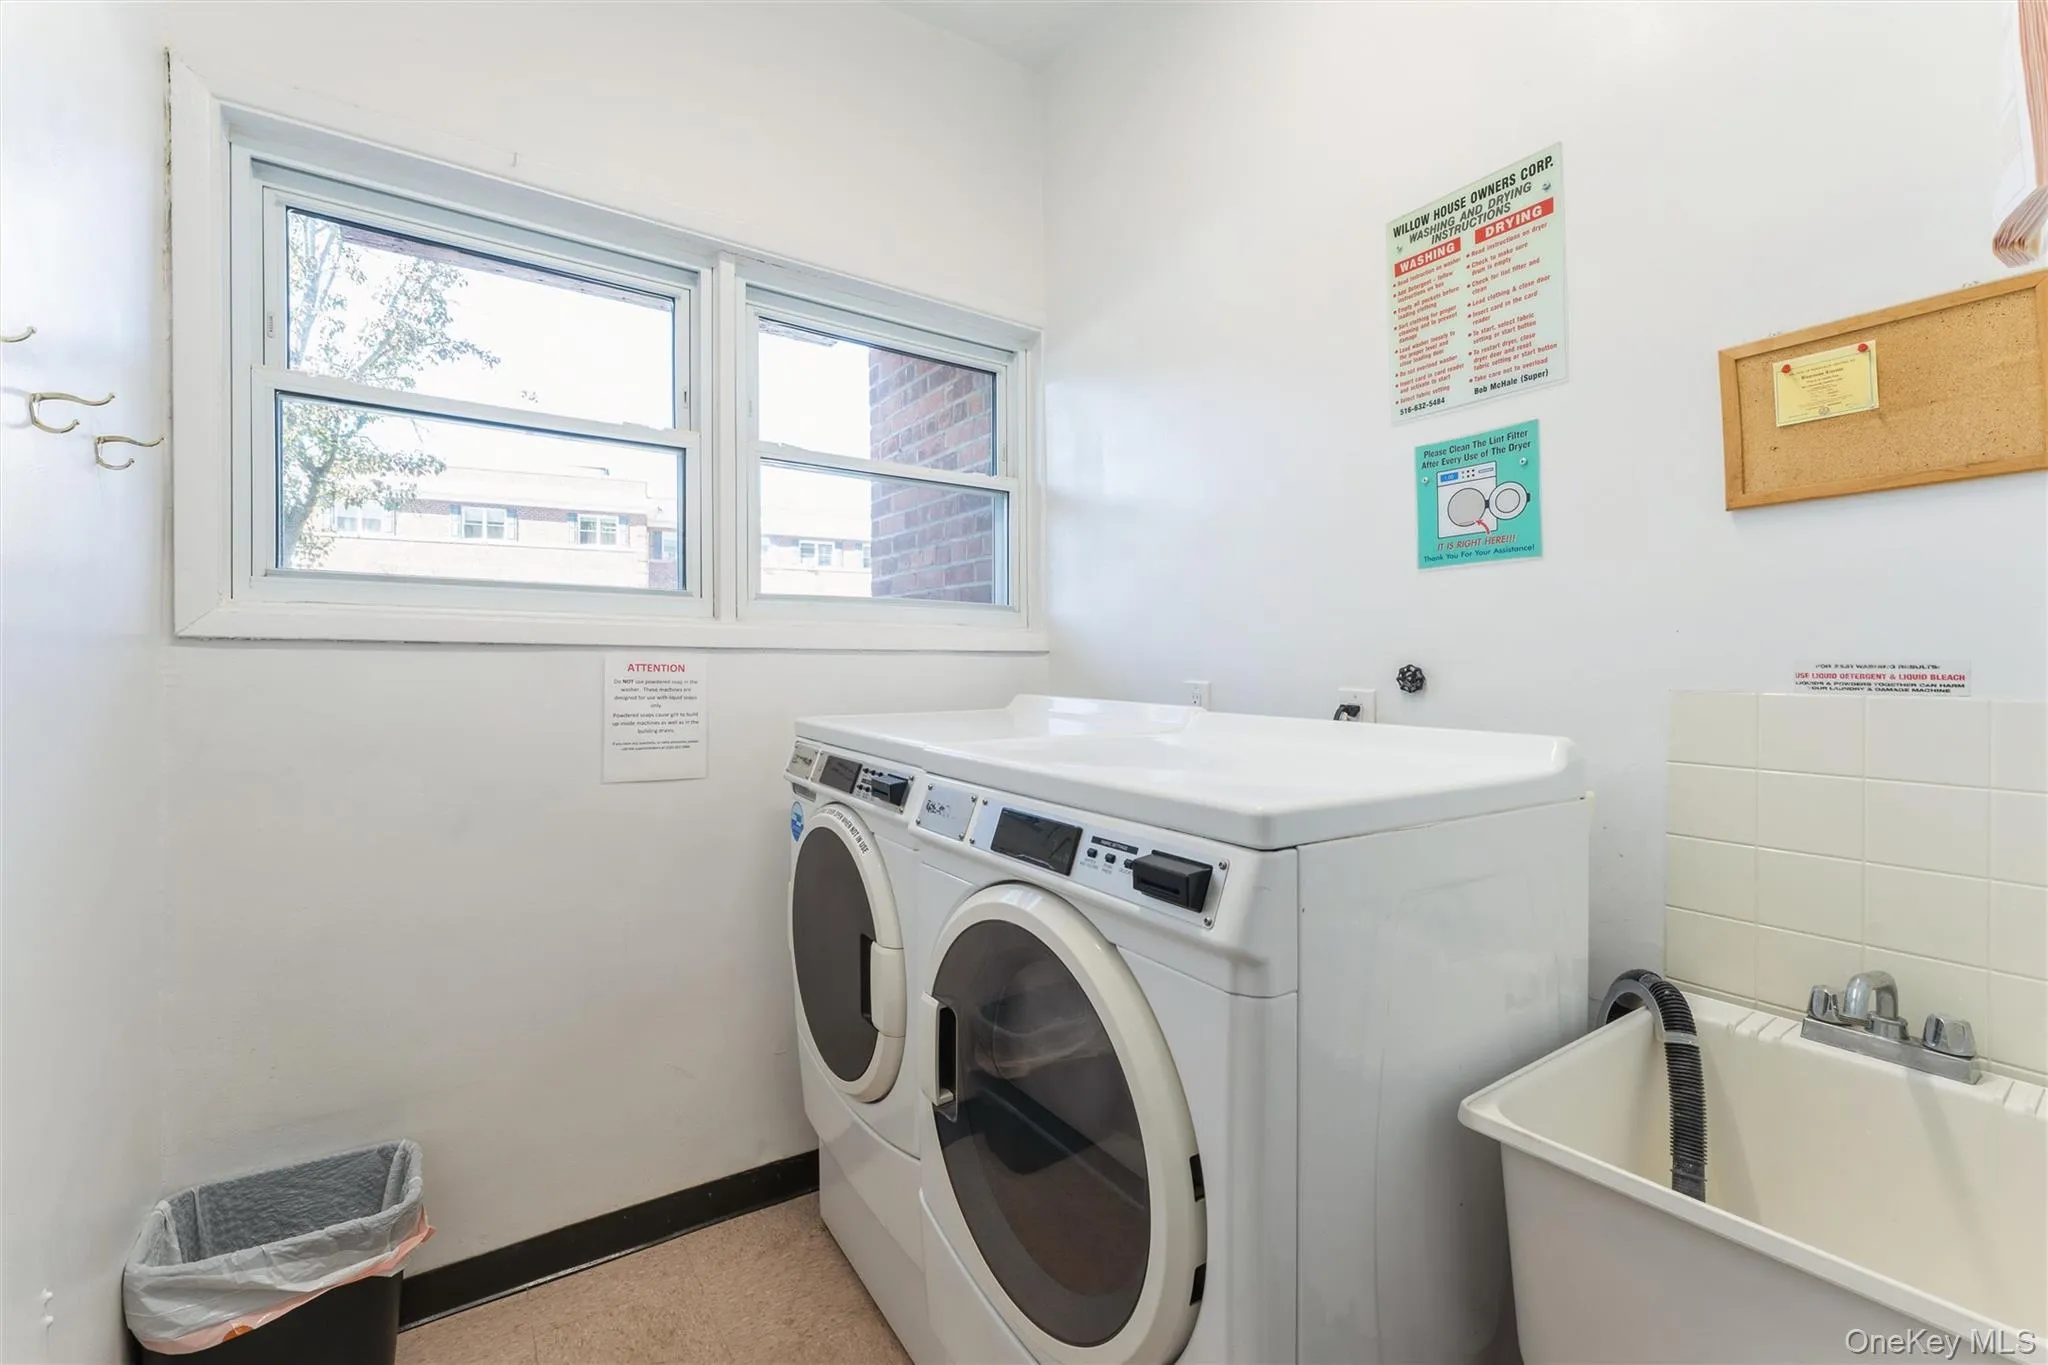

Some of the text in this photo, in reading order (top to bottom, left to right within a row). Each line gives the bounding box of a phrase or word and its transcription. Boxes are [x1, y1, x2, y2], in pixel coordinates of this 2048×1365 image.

[1393, 156, 1553, 238] WILLOW HOUSE OWNERS CORP.
[1410, 182, 1532, 243] WASHING AND DRYING
[1432, 202, 1511, 244] INSTRUCTIONS
[1486, 206, 1542, 237] DRYING
[1471, 248, 1485, 256] Read
[1487, 234, 1520, 250] instructions
[1532, 222, 1547, 232] dryer
[1400, 243, 1454, 272] WASHING
[1444, 258, 1460, 267] washer
[1472, 258, 1488, 268] Check
[1498, 248, 1513, 258] make
[1515, 242, 1528, 251] sure
[1472, 267, 1485, 276] drum
[1494, 258, 1511, 267] empty
[1472, 277, 1488, 287] Check
[1512, 263, 1526, 272] filter
[1529, 258, 1540, 266] and
[1442, 287, 1459, 296] before
[1472, 286, 1487, 295] clean
[1472, 297, 1485, 306] Load
[1487, 289, 1510, 301] clothing
[1537, 275, 1550, 283] door
[1473, 308, 1488, 317] Insert
[1490, 302, 1503, 311] card
[1524, 291, 1537, 300] card
[1473, 316, 1490, 325] reader
[1498, 318, 1515, 328] select
[1517, 313, 1534, 322] fabric
[1473, 335, 1492, 344] setting
[1502, 327, 1515, 335] start
[1517, 321, 1536, 330] button
[1481, 343, 1500, 353] restart
[1520, 333, 1535, 341] close
[1492, 356, 1511, 366] setting
[1522, 349, 1535, 357] start
[1538, 344, 1557, 353] button
[1517, 342, 1531, 350] reset
[1522, 357, 1548, 369] overload
[1474, 369, 1548, 395] Bob McHale (Super)
[1400, 397, 1445, 415] 516-632-5484
[1422, 461, 1439, 469] After
[1441, 457, 1461, 466] Every
[1481, 449, 1488, 458] of
[1491, 447, 1506, 455] The
[1508, 441, 1530, 452] Dryer
[1424, 431, 1528, 458] Please Clean The Lint Filter
[1424, 554, 1443, 562] Thank
[1493, 544, 1534, 554] Assistance!
[1456, 538, 1481, 548] RIGHT
[627, 664, 686, 672] ATTENTION
[841, 816, 854, 829] WHEN
[850, 826, 860, 837] NOT
[855, 834, 863, 844] IN
[859, 840, 869, 854] USE
